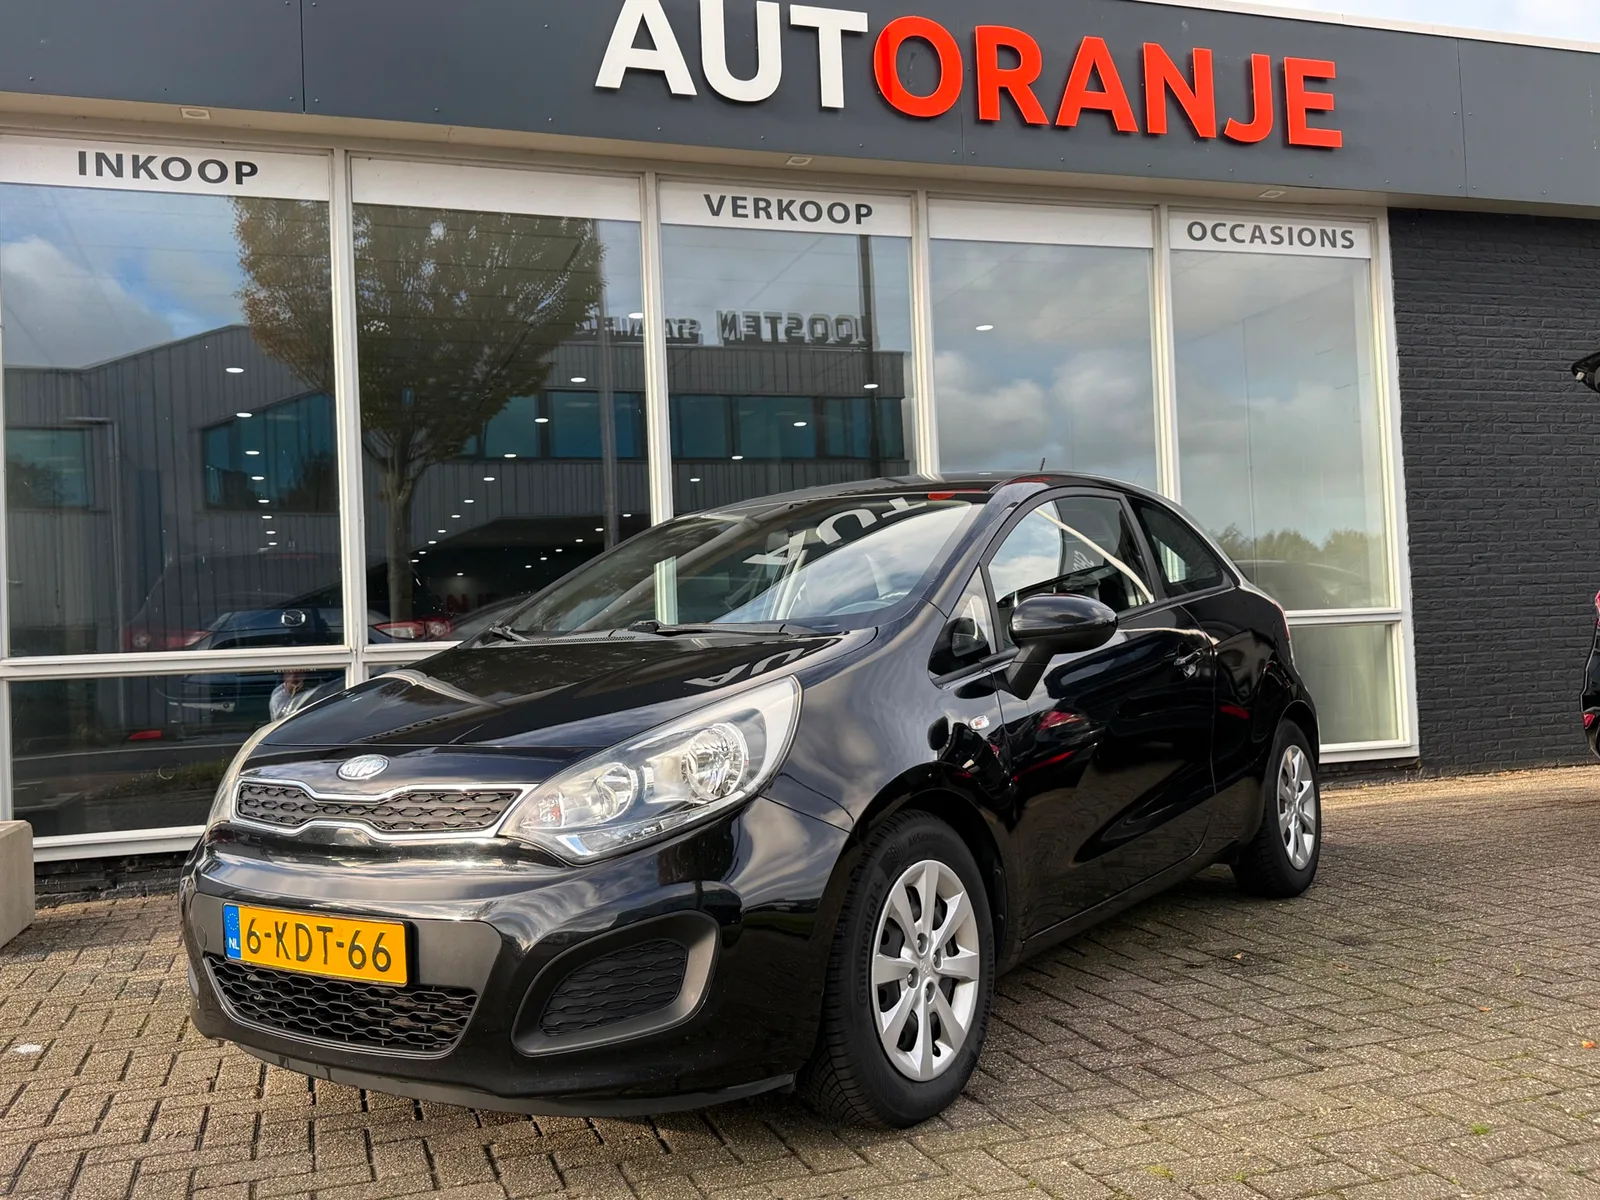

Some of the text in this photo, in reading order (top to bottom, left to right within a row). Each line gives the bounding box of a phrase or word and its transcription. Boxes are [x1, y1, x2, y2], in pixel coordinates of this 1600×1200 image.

[595, 0, 1343, 148] AUTORANJE
[78, 151, 259, 185] INKOOP
[703, 194, 873, 225] VERKOOP
[1187, 221, 1355, 249] OCCASIONS
[228, 936, 240, 950] NL
[247, 917, 392, 972] 6-KDT-66
